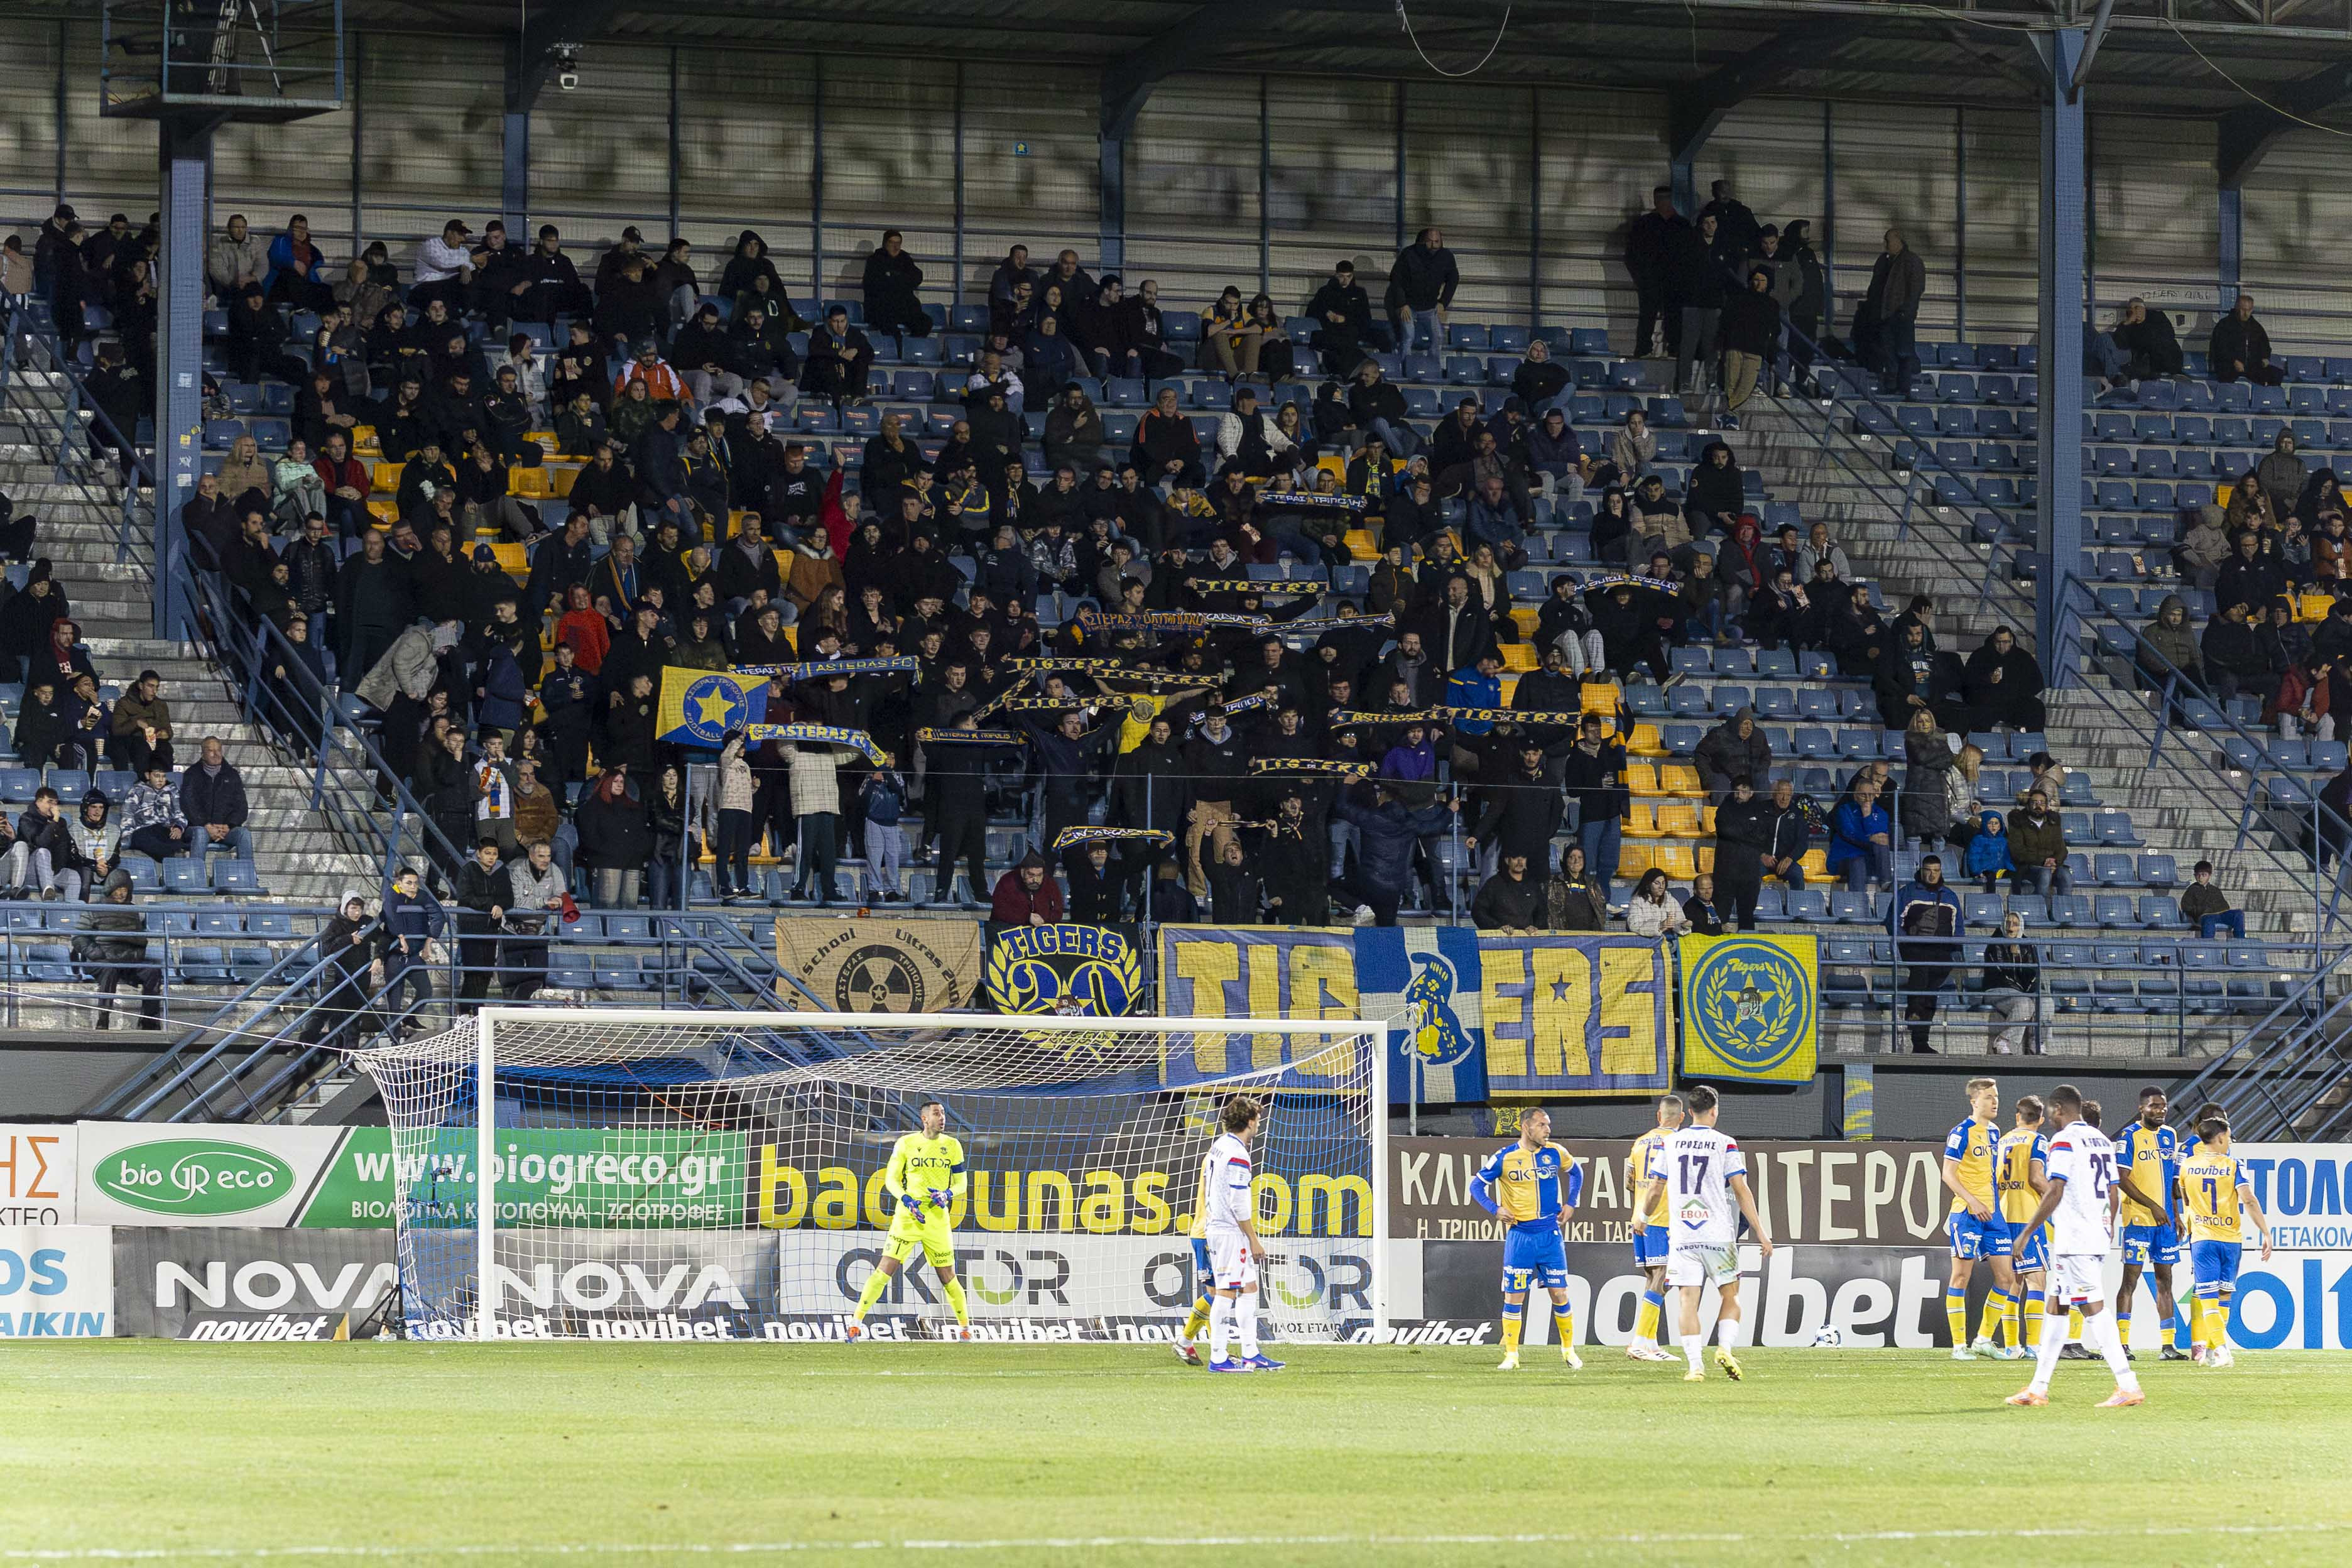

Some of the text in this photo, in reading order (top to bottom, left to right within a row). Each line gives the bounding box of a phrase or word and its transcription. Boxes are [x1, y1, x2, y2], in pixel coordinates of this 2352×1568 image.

[775, 725, 849, 741] ASTERAS
[895, 927, 943, 969] Ultras
[999, 924, 1121, 963] TIGERS
[839, 954, 864, 1000] ΑΣΤΕΡΑΣ
[1678, 1154, 1709, 1194] 17
[2090, 1153, 2111, 1199] 25
[2187, 1165, 2231, 1177] novibet
[465, 1202, 587, 1220] ΚΤΟΠΟΥΛΑ
[607, 1203, 725, 1222] ΖΩΟΤΡΟΦΕΣ
[2202, 1179, 2217, 1215] 7
[189, 1312, 328, 1341] novibet
[588, 1314, 734, 1341] novibet
